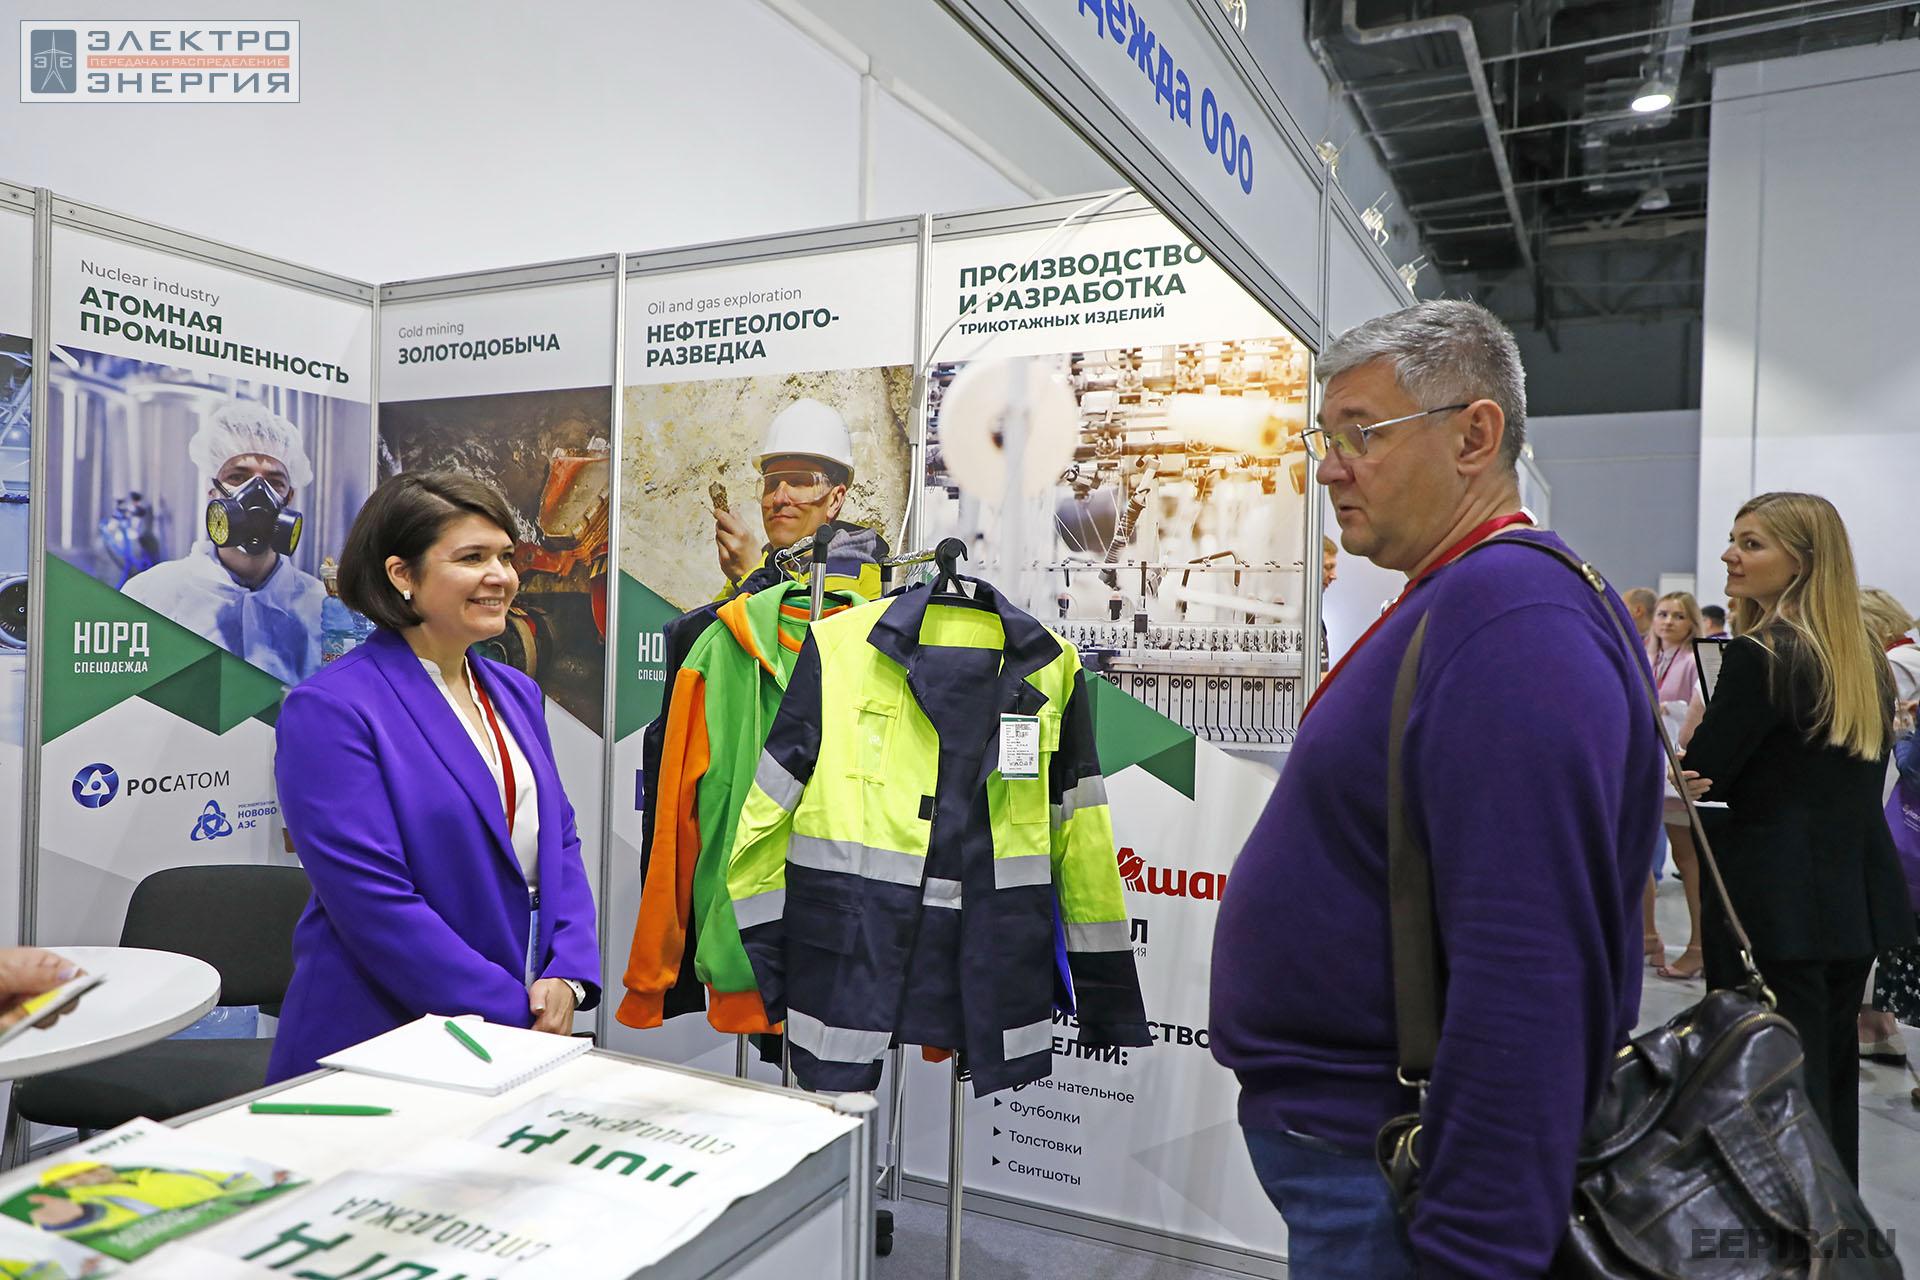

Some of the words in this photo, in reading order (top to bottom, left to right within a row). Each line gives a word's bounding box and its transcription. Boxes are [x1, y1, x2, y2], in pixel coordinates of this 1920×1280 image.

[1201, 88, 1253, 194] ООО
[959, 242, 1206, 288] ПРОИЗВОДСТВО
[81, 259, 148, 287] Nuclear
[153, 276, 220, 306] industry
[959, 293, 977, 315] И
[987, 272, 1187, 313] РАЗРАБОТКА
[80, 285, 222, 335] АТОМНАЯ
[648, 302, 665, 315] Oil
[669, 298, 693, 313] and
[697, 298, 720, 313] gas
[724, 287, 802, 308] exploration
[399, 326, 423, 339] Gold
[426, 321, 464, 337] mining
[647, 308, 840, 344] НЕФТЕГЕОЛОГО-
[959, 313, 1080, 335] ТРИКОТАЖНЫХ
[1085, 303, 1165, 324] ИЗДЕЛИЙ
[80, 311, 349, 384] ПРОМЫШЛЕННОСТЬ
[398, 333, 560, 364] ЗОЛОТОДОБЫЧА
[646, 339, 767, 367] РАЗВЕДКА
[74, 621, 149, 657] НОРД
[74, 660, 149, 674] СПЕЦОДЕЖДА
[127, 770, 230, 796] РОСАТОМ
[238, 820, 256, 829] АЭС
[1058, 1081, 1135, 1103] нательное
[1009, 1101, 1081, 1124] Футболки
[1009, 1129, 1082, 1155] Толстовки
[1008, 1160, 1081, 1185] Свитшоты
